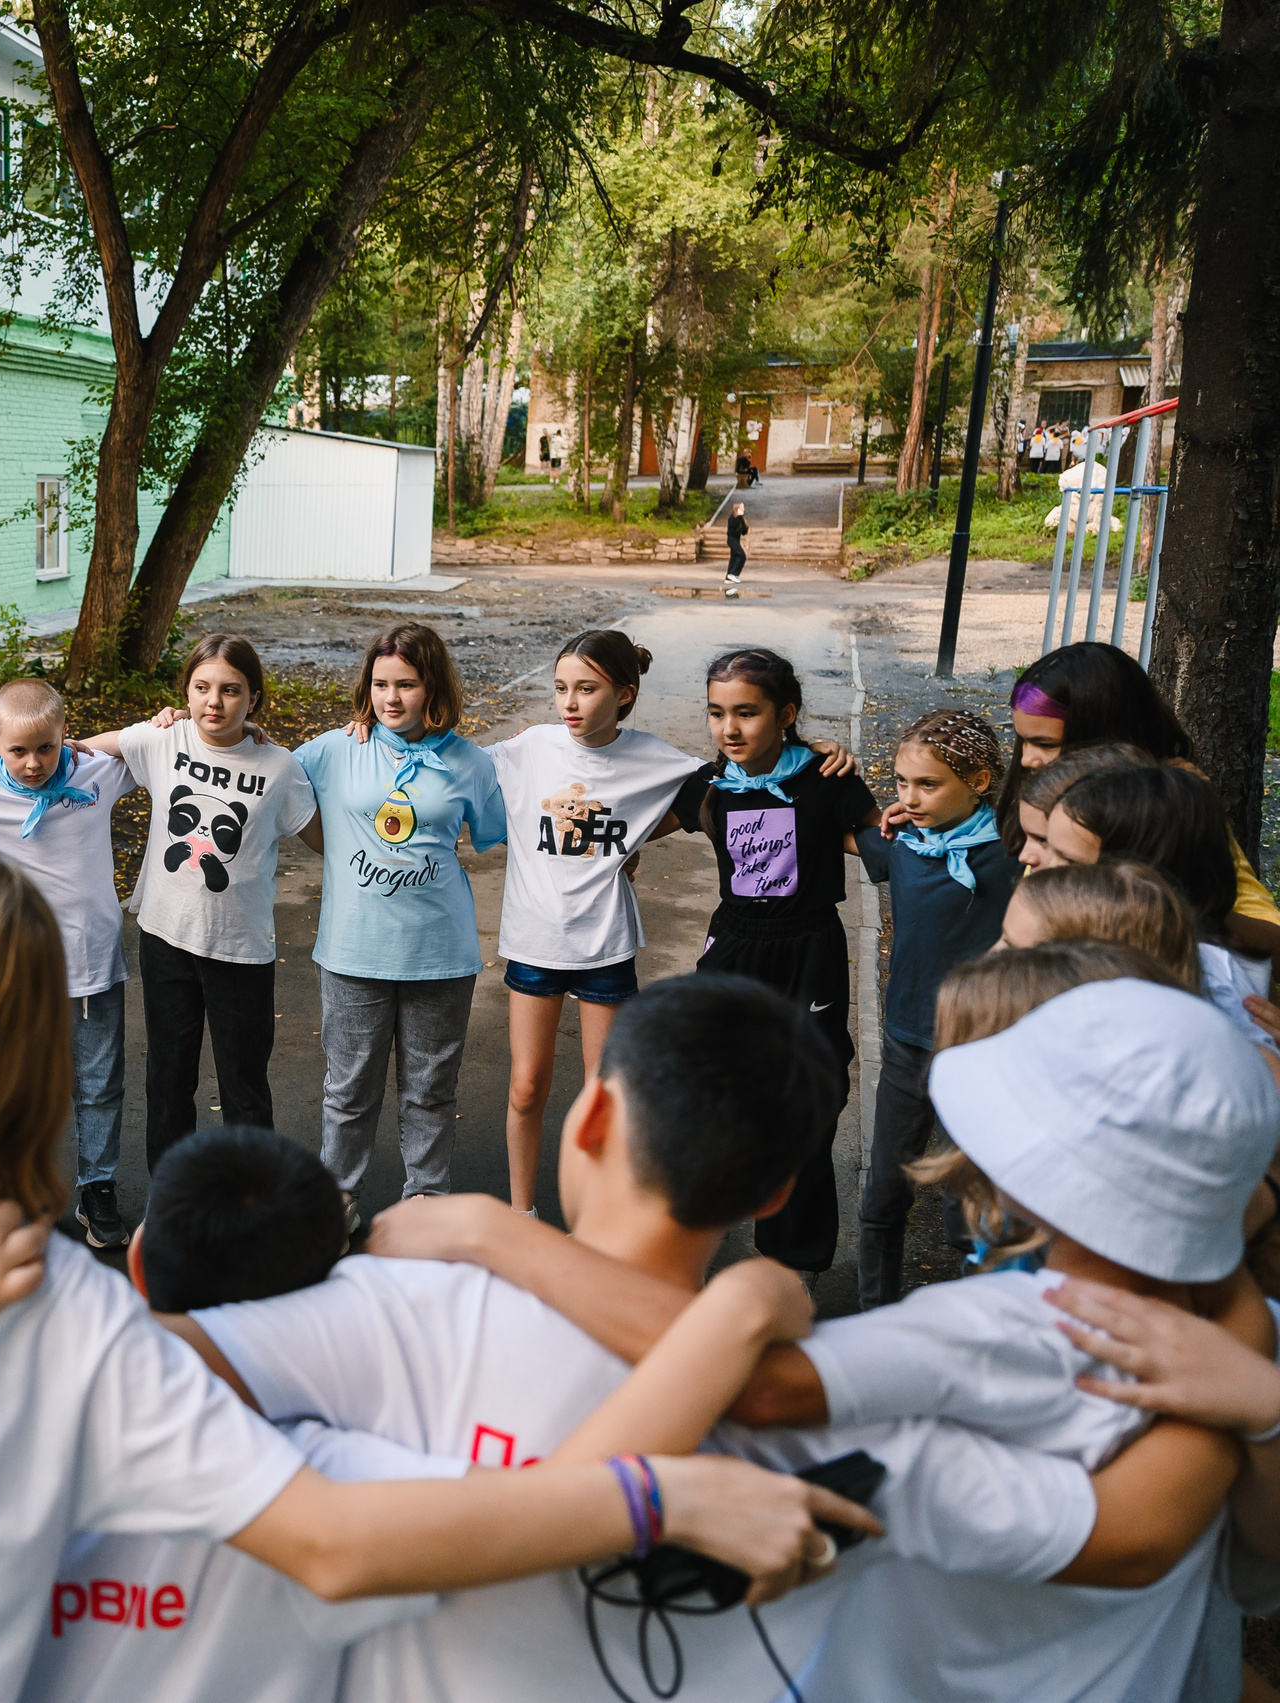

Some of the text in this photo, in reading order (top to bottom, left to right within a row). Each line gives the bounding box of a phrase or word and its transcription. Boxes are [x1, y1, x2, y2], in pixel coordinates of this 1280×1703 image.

[174, 752, 266, 797] FOR U!
[537, 807, 628, 857] ADER
[730, 811, 766, 847] good
[739, 830, 794, 859] things
[349, 849, 441, 897] Ayogado
[737, 858, 771, 878] take
[755, 875, 793, 895] time
